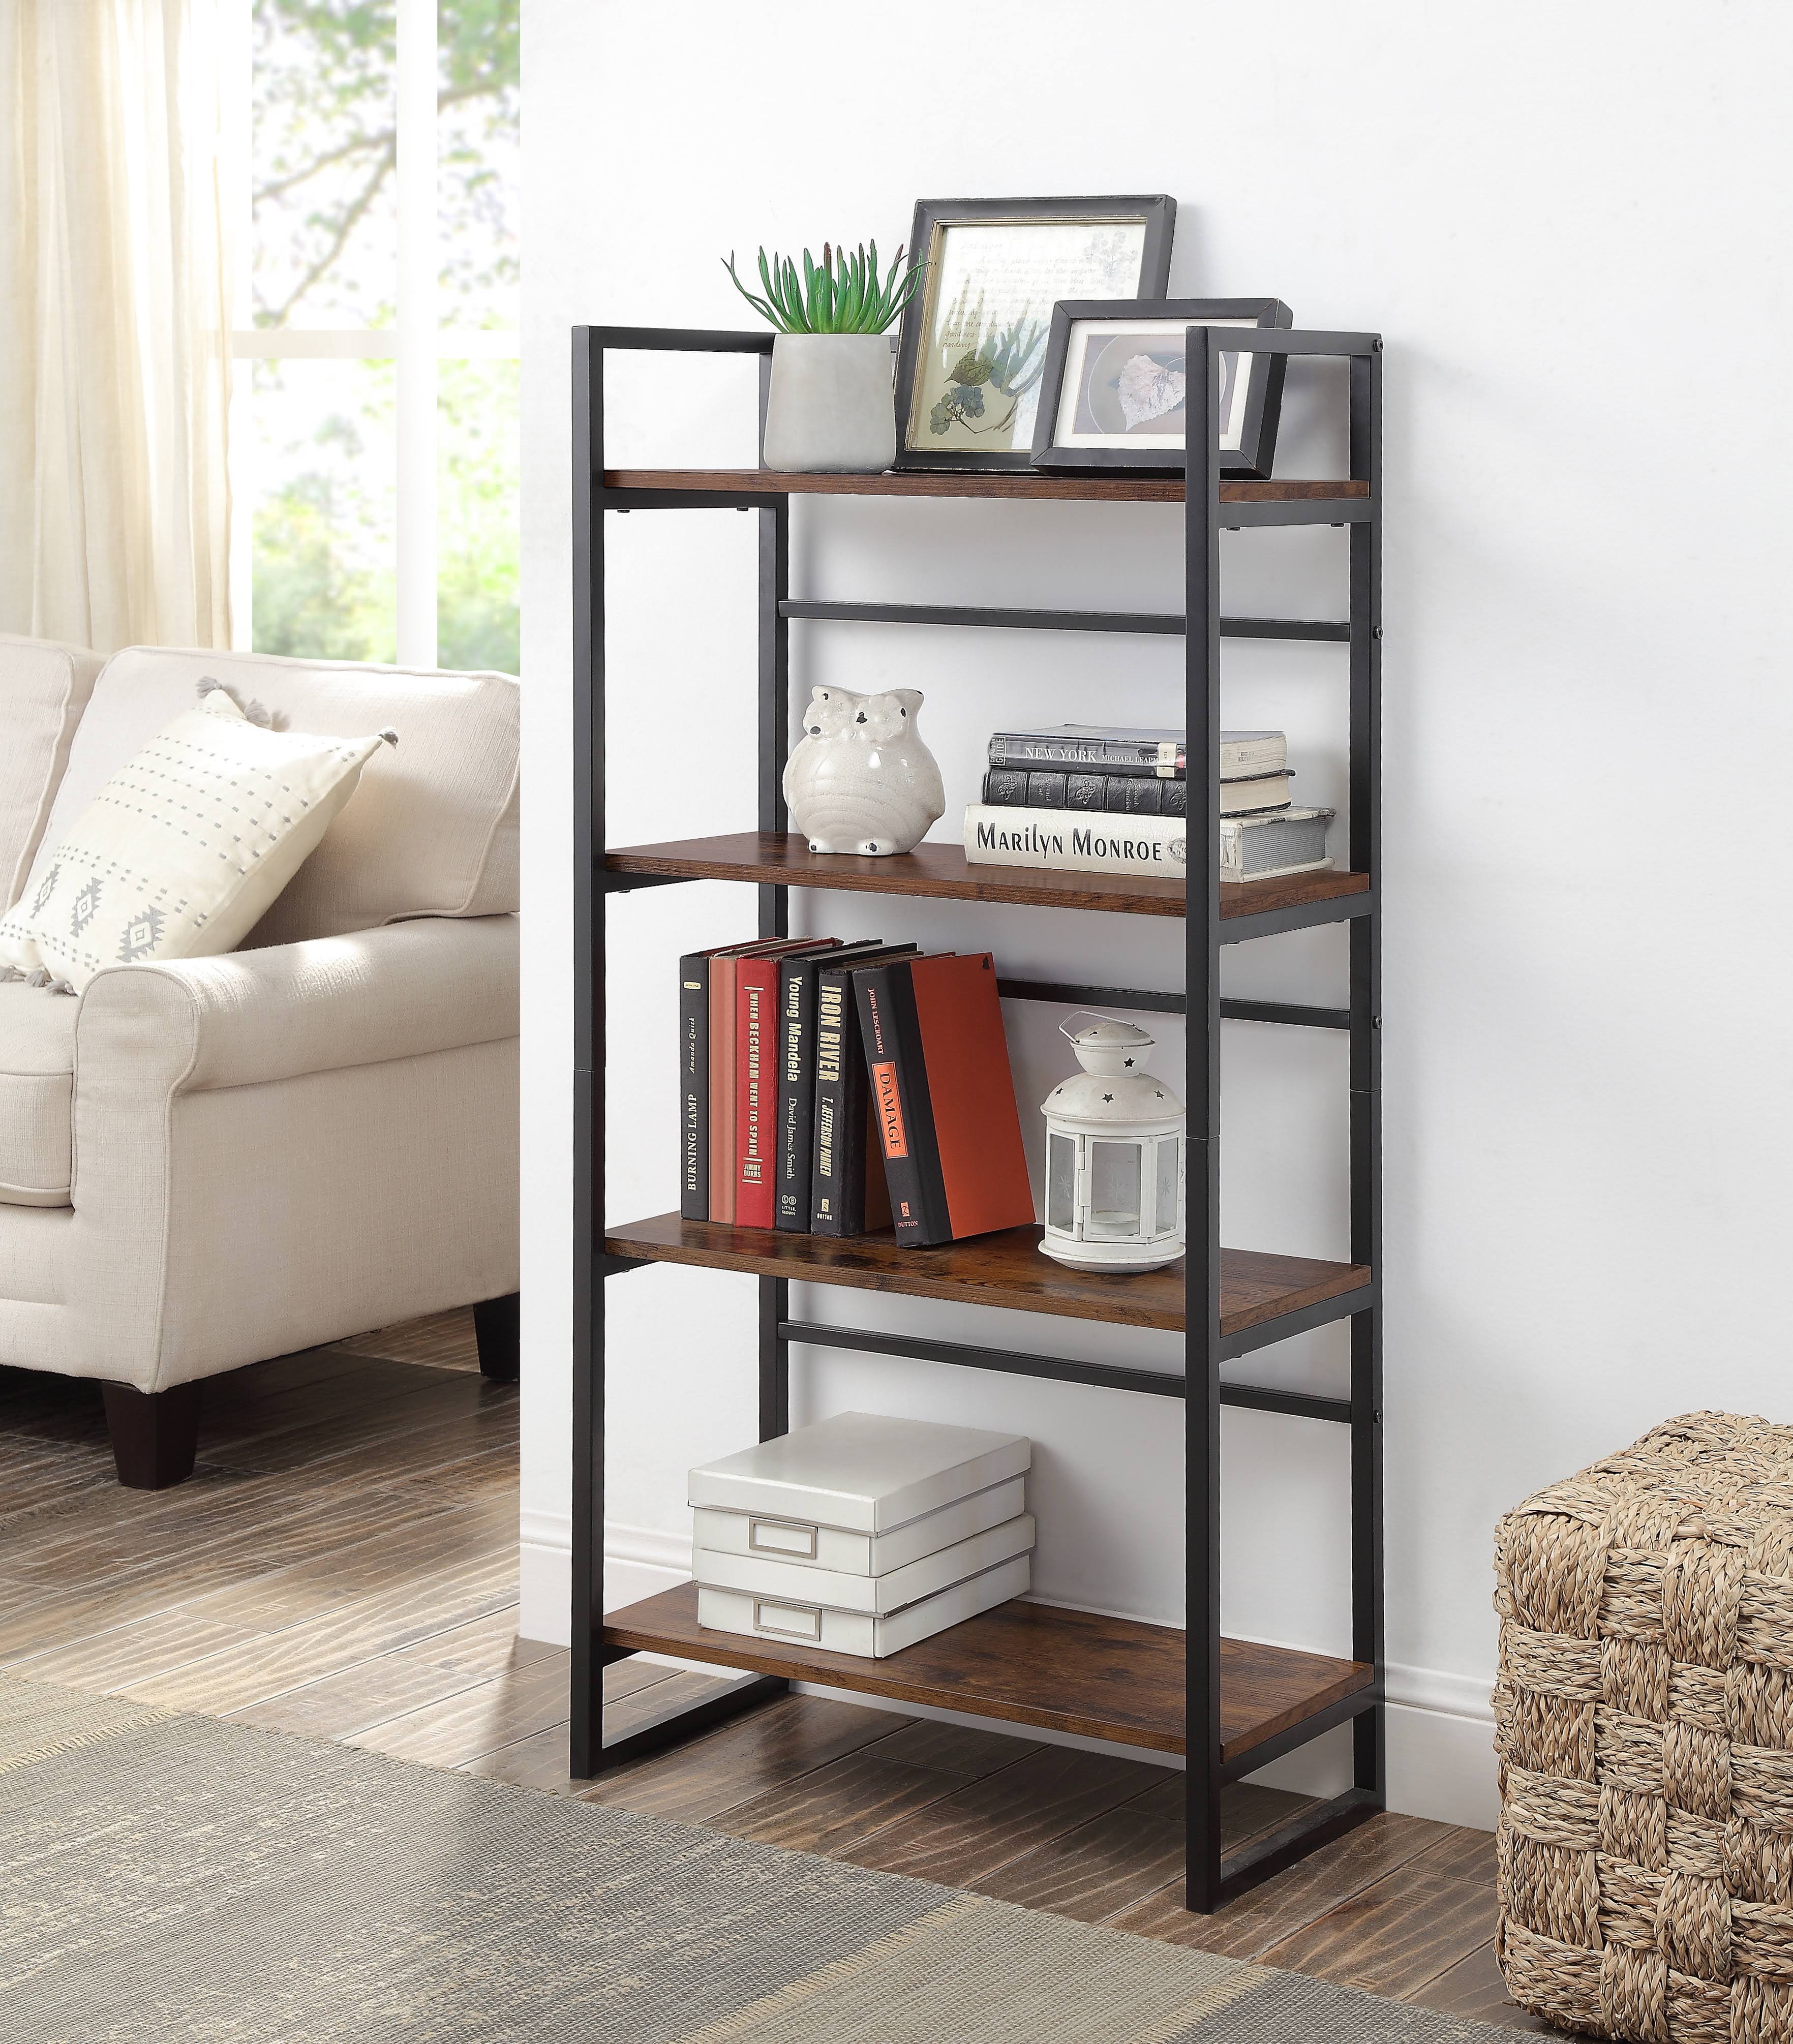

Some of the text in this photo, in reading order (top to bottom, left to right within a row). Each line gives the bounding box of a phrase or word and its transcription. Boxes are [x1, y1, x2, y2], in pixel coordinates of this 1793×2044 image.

[995, 739, 1005, 763] GUIDE
[1024, 747, 1097, 762] NEW YORK
[1102, 754, 1134, 762] MICHAEL
[786, 976, 803, 1082] Young Mandela
[818, 986, 842, 1082] IRON RIVER
[867, 988, 884, 1055] JOHN LESCROART
[748, 993, 759, 1155] WHEN BECKHAM WENT TO SPAIN
[687, 1094, 697, 1191] BURNING LAMP
[786, 1097, 797, 1179] David James Smith
[820, 1104, 833, 1148] JEFFERSON
[879, 1072, 901, 1149] DAMAGE
[743, 1170, 761, 1178] BURNS
[819, 1146, 832, 1177] PARKER
